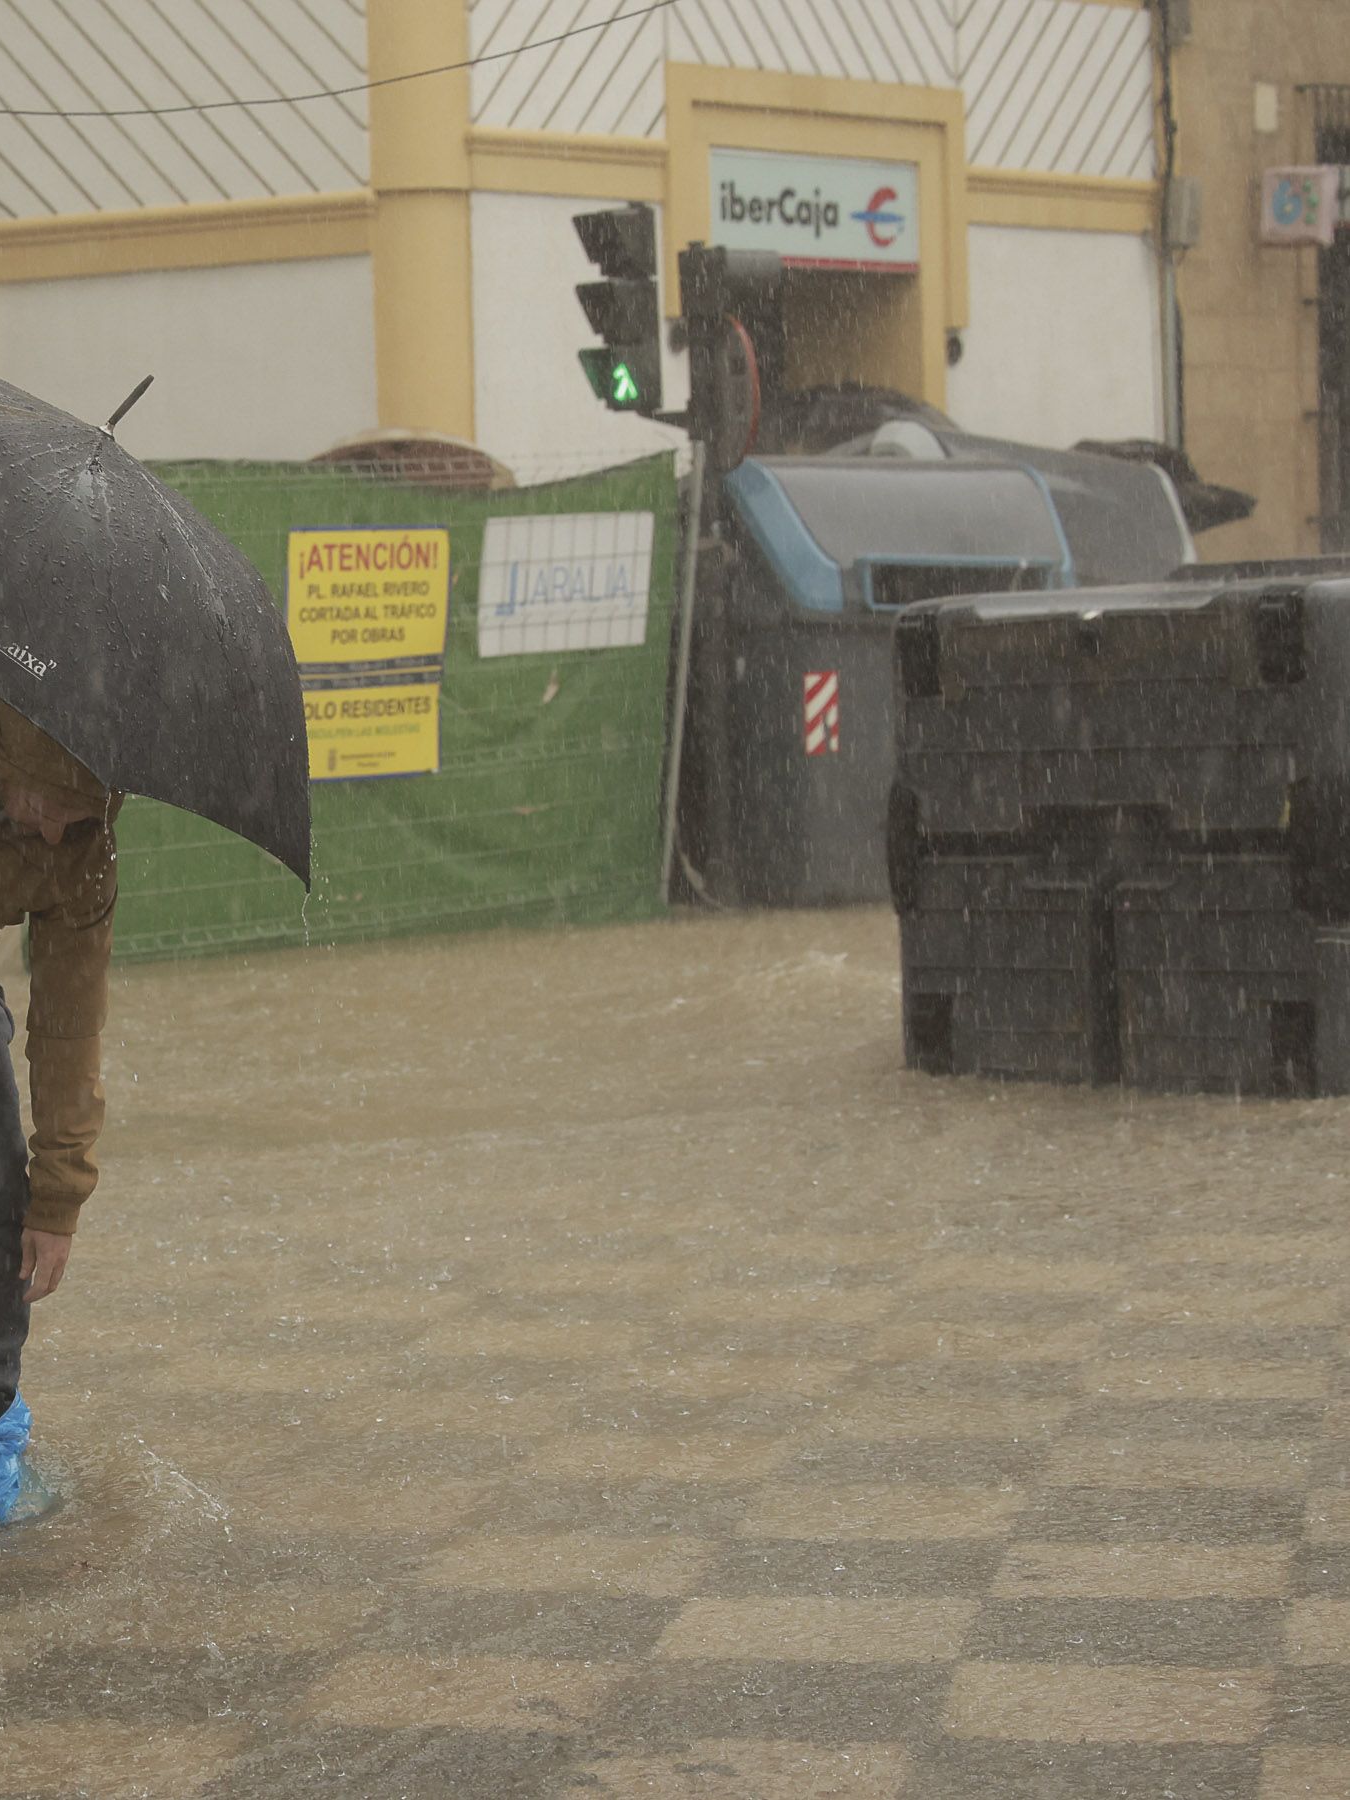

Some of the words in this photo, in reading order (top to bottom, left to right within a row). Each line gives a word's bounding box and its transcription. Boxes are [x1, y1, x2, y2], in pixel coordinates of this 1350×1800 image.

[720, 180, 839, 239] iberCaja
[299, 534, 439, 579] ¡ATENCIÓN!
[331, 581, 378, 598] RAFAEL
[383, 580, 430, 597] RIVERO
[299, 605, 361, 623] CORTADA
[363, 605, 378, 621] AL
[331, 628, 358, 645] POR
[361, 627, 405, 643] OBRAS
[304, 701, 337, 720] OLO
[341, 696, 431, 719] RESIDENTES
